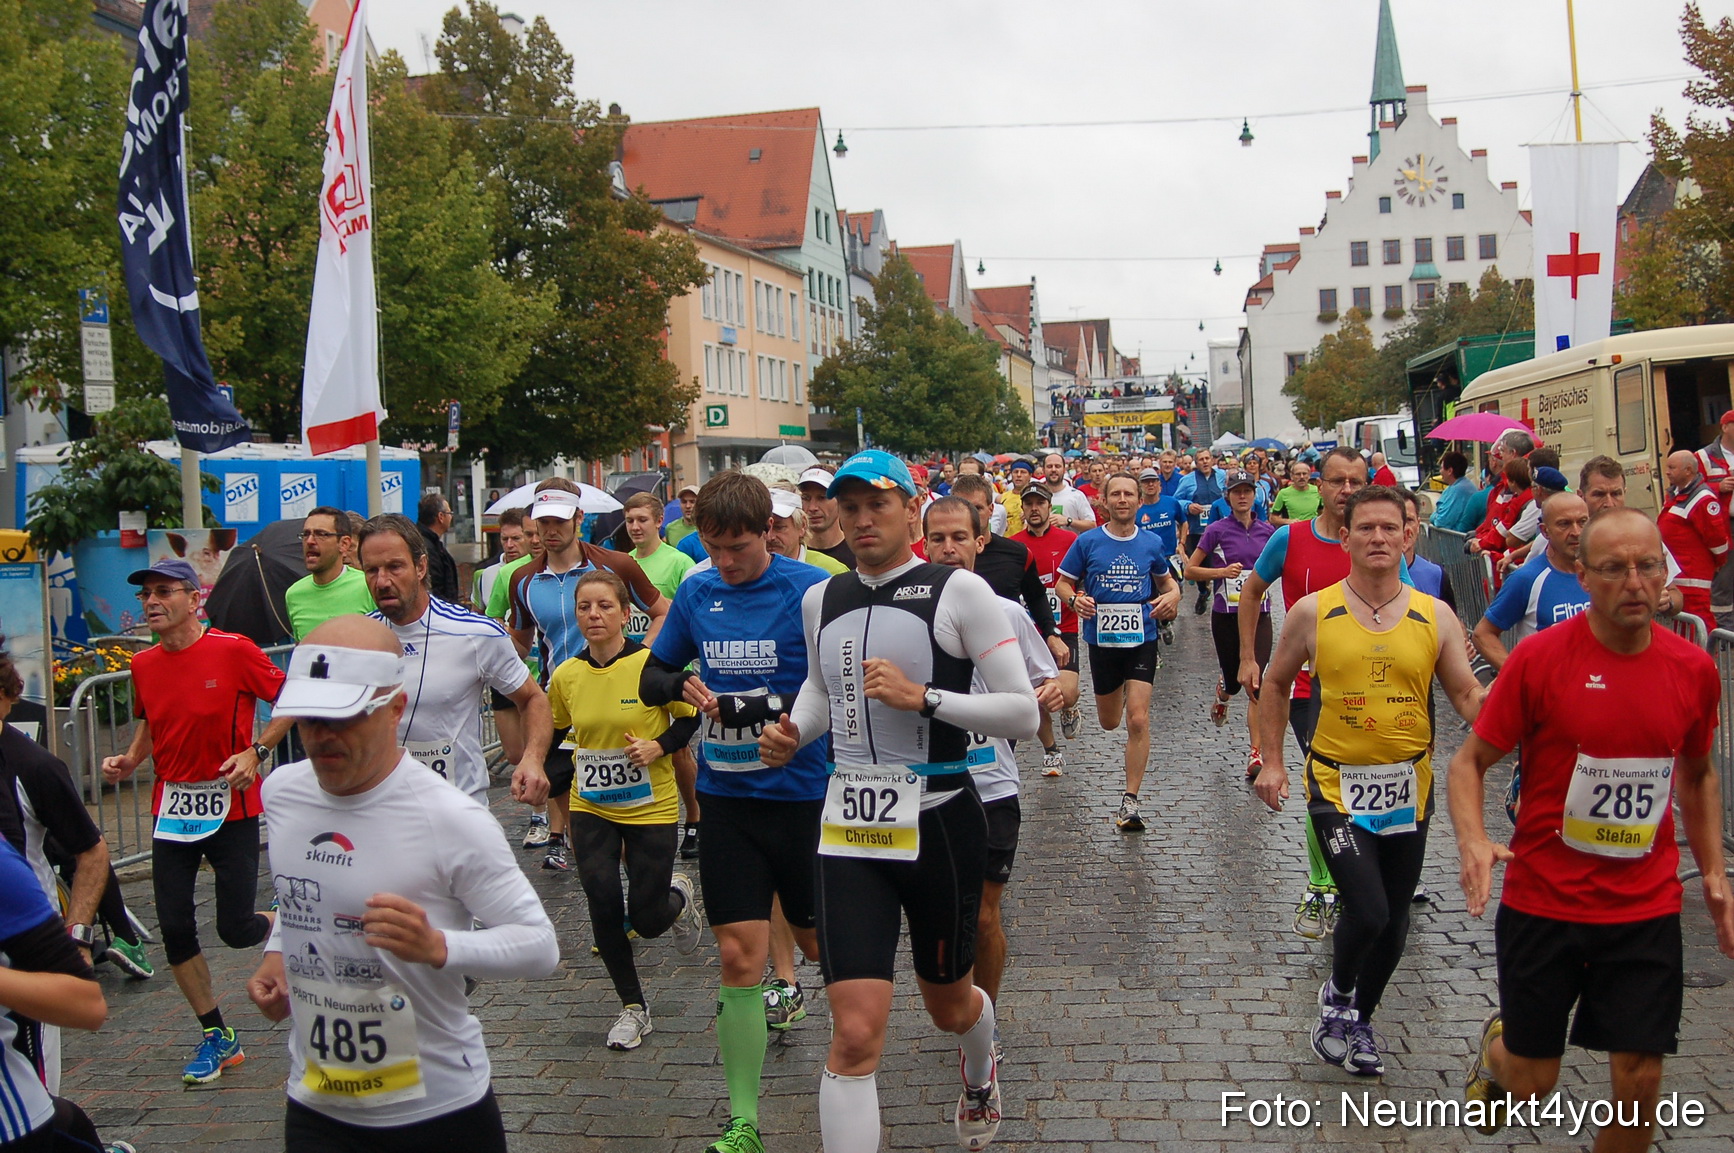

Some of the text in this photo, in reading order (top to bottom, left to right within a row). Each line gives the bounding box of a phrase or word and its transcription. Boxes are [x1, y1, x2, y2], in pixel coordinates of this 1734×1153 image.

[1538, 386, 1588, 415] Bayerisches
[708, 407, 725, 424] D
[1113, 415, 1144, 423] START
[1539, 418, 1562, 436] Rotes
[382, 475, 402, 493] IXI
[1147, 520, 1172, 529] BARCLAYS
[894, 585, 933, 597] ARNDT
[1102, 615, 1139, 631] 2256
[703, 640, 777, 659] HUBER
[717, 659, 774, 667] TECHNOLOGY
[842, 640, 858, 738] TSG 08 Roth
[1343, 697, 1366, 706] Seidl
[409, 749, 439, 757] umarkt
[577, 754, 598, 762] PARTL
[584, 761, 642, 788] 2933
[855, 774, 902, 783] Neumarkt
[1341, 770, 1406, 780] PARTL Neumarkt
[1576, 763, 1659, 778] PARTL Neumarkt
[184, 783, 217, 791] Neumarkt
[1349, 779, 1411, 811] 2254
[167, 791, 224, 816] 2386
[599, 791, 632, 802] Angela
[843, 787, 899, 823] 502
[1588, 783, 1654, 819] 285
[183, 822, 202, 833] Karl
[1369, 816, 1393, 829] Klaus
[845, 829, 893, 845] Christof
[1595, 827, 1641, 844] Stefan
[305, 849, 353, 867] skinfit
[334, 962, 384, 979] ROCK
[292, 986, 385, 1013] PARTL Neumarkt
[310, 1014, 387, 1064] 485
[317, 1070, 384, 1093] Thomas
